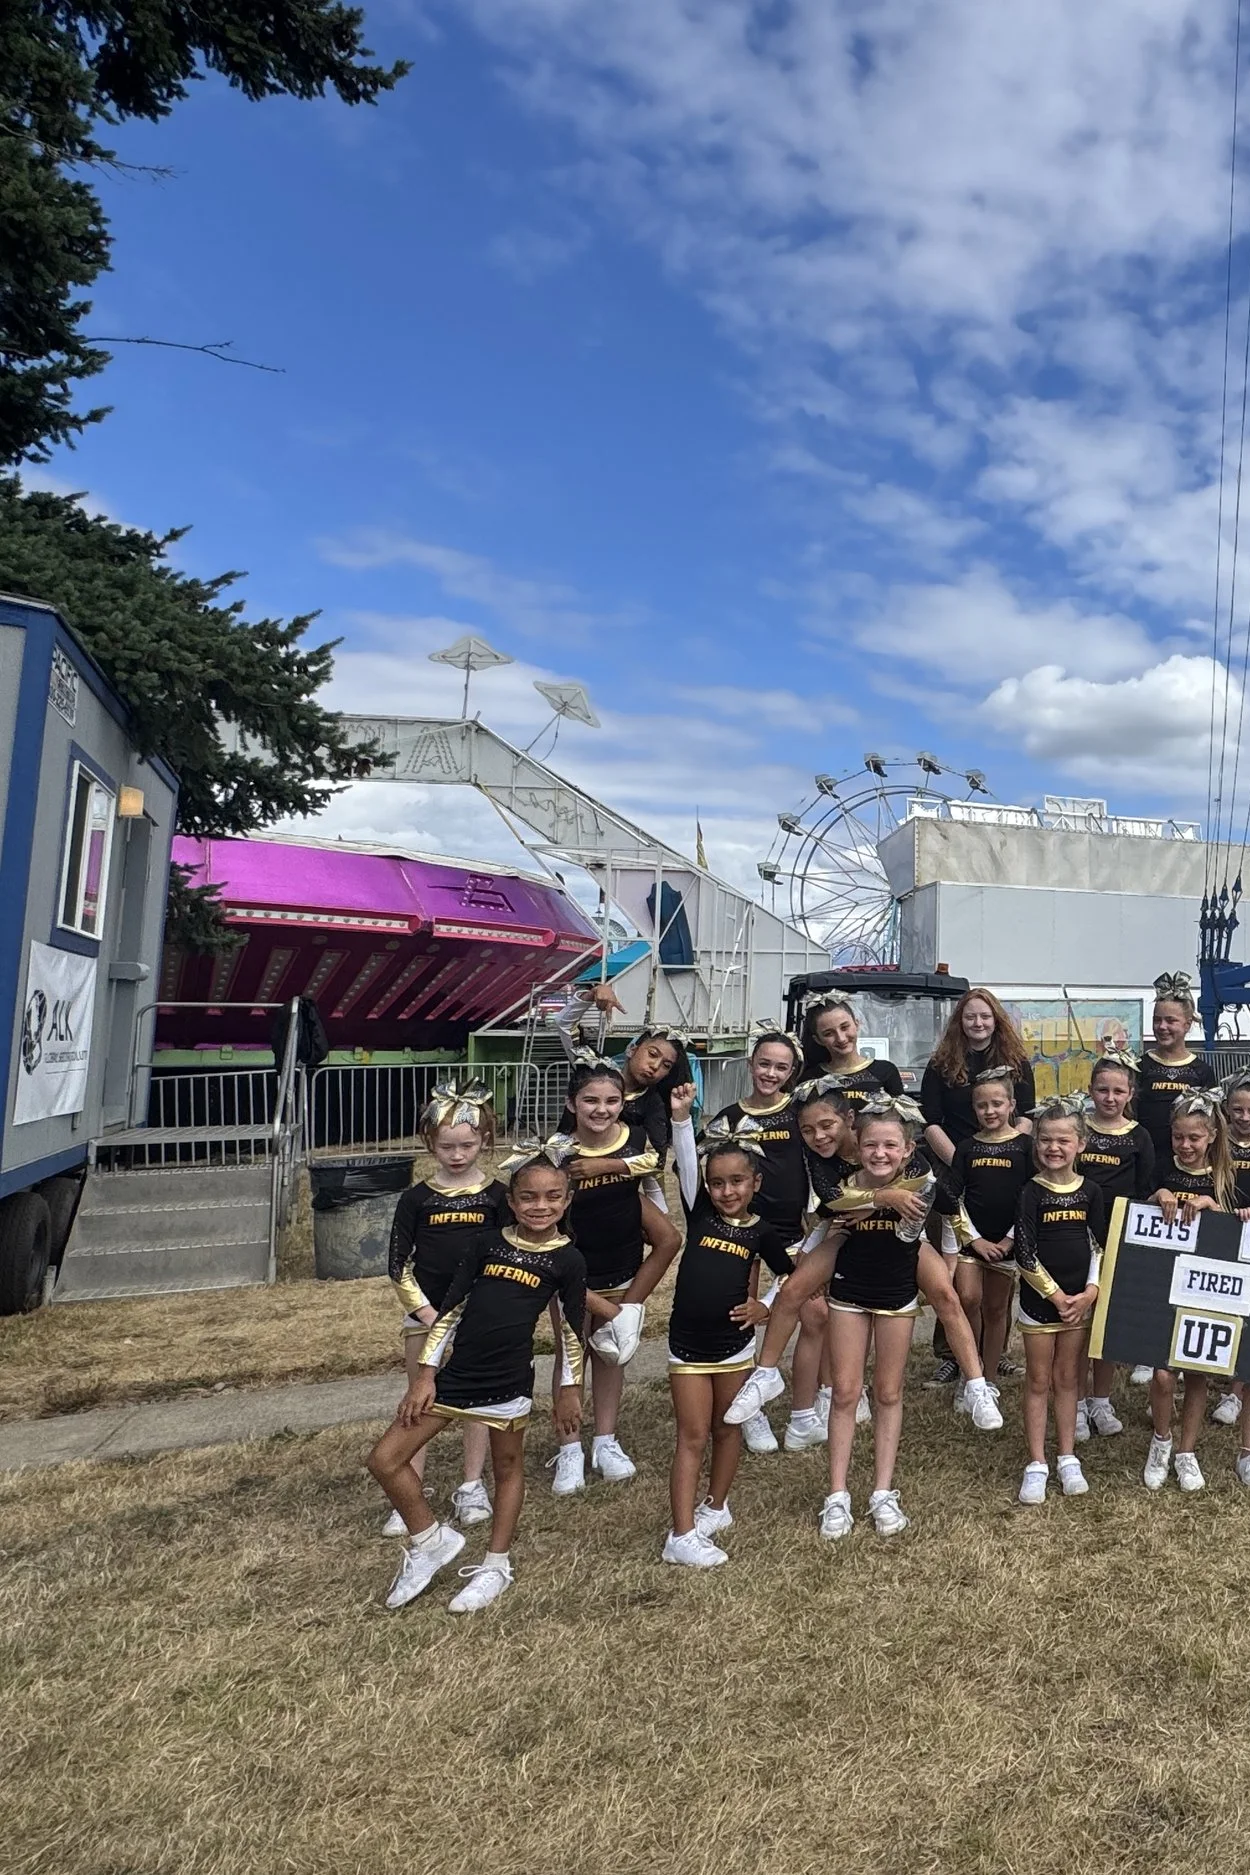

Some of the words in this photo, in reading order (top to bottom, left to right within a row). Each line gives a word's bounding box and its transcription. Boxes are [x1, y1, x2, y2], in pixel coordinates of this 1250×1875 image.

[756, 1130, 790, 1141] FERNO
[971, 1157, 1012, 1168] INFERNO
[1081, 1152, 1121, 1166] INFERNO
[429, 1212, 485, 1225] INFERNO
[856, 1219, 898, 1231] INFER
[1134, 1213, 1191, 1242] LETS
[700, 1236, 750, 1261] INFERNO
[483, 1263, 541, 1289] INFERNO
[1186, 1269, 1243, 1297] FIRED
[1182, 1319, 1232, 1362] UP
